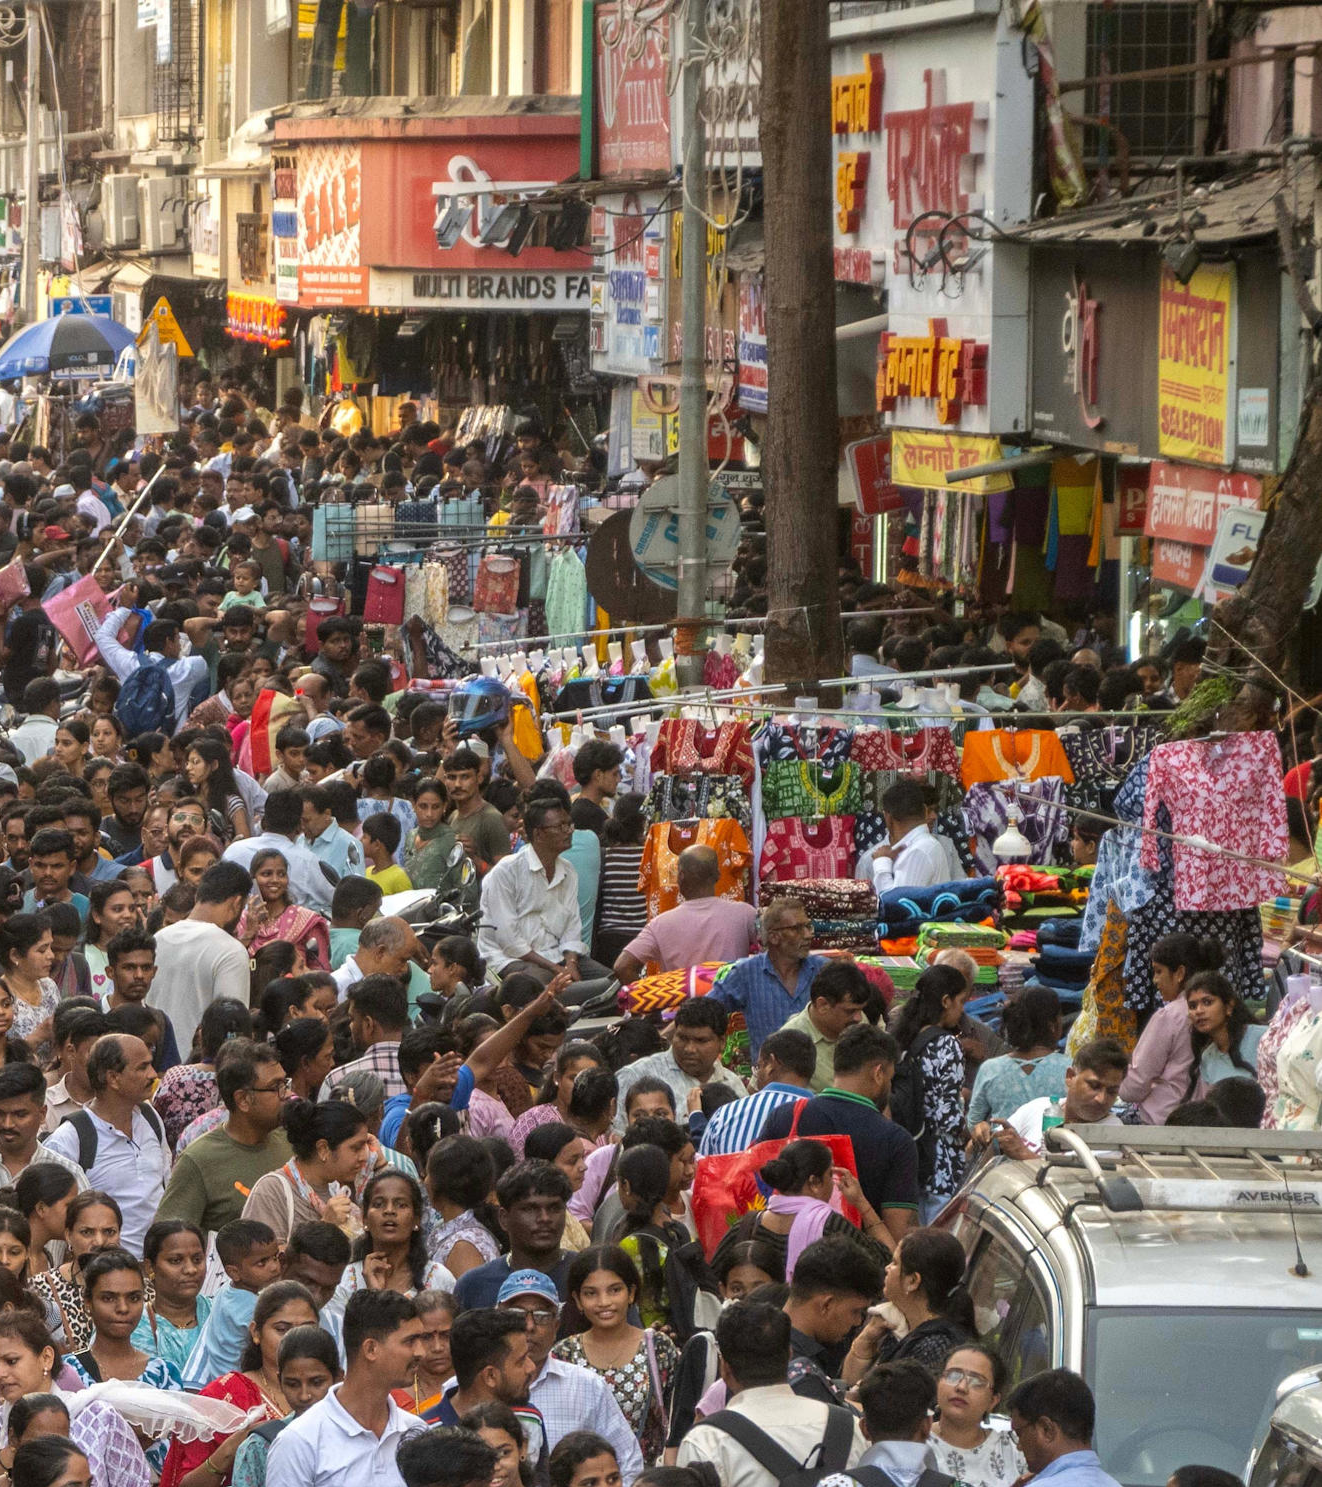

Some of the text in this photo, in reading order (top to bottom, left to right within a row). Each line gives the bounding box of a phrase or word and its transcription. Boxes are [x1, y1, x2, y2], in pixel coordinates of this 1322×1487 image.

[305, 164, 360, 252] SALE
[412, 275, 460, 298] MULTI
[467, 275, 556, 299] BRANDS
[1161, 404, 1224, 449] SELECTION
[1236, 1192, 1320, 1206] AVENGER
